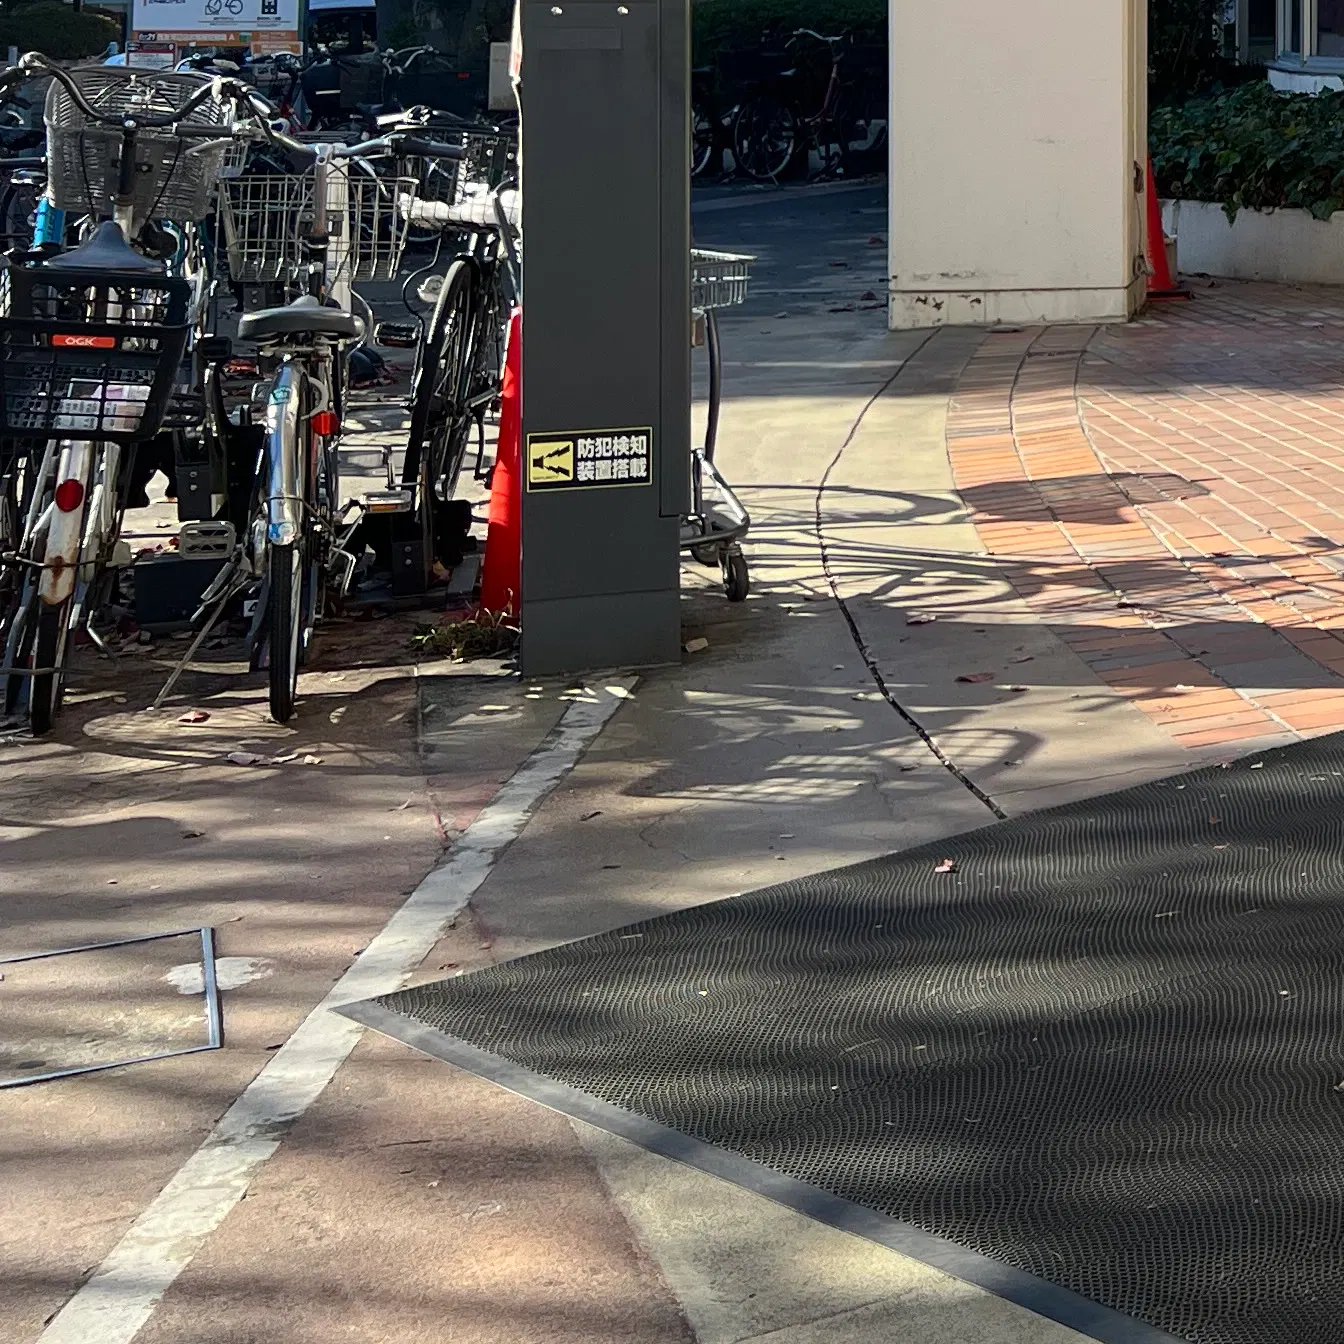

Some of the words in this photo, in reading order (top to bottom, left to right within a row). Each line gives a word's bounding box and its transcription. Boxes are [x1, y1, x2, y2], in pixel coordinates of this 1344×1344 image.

[65, 336, 96, 346] OGK
[577, 435, 647, 459] 防犯検知
[576, 457, 648, 482] 装置搭載
